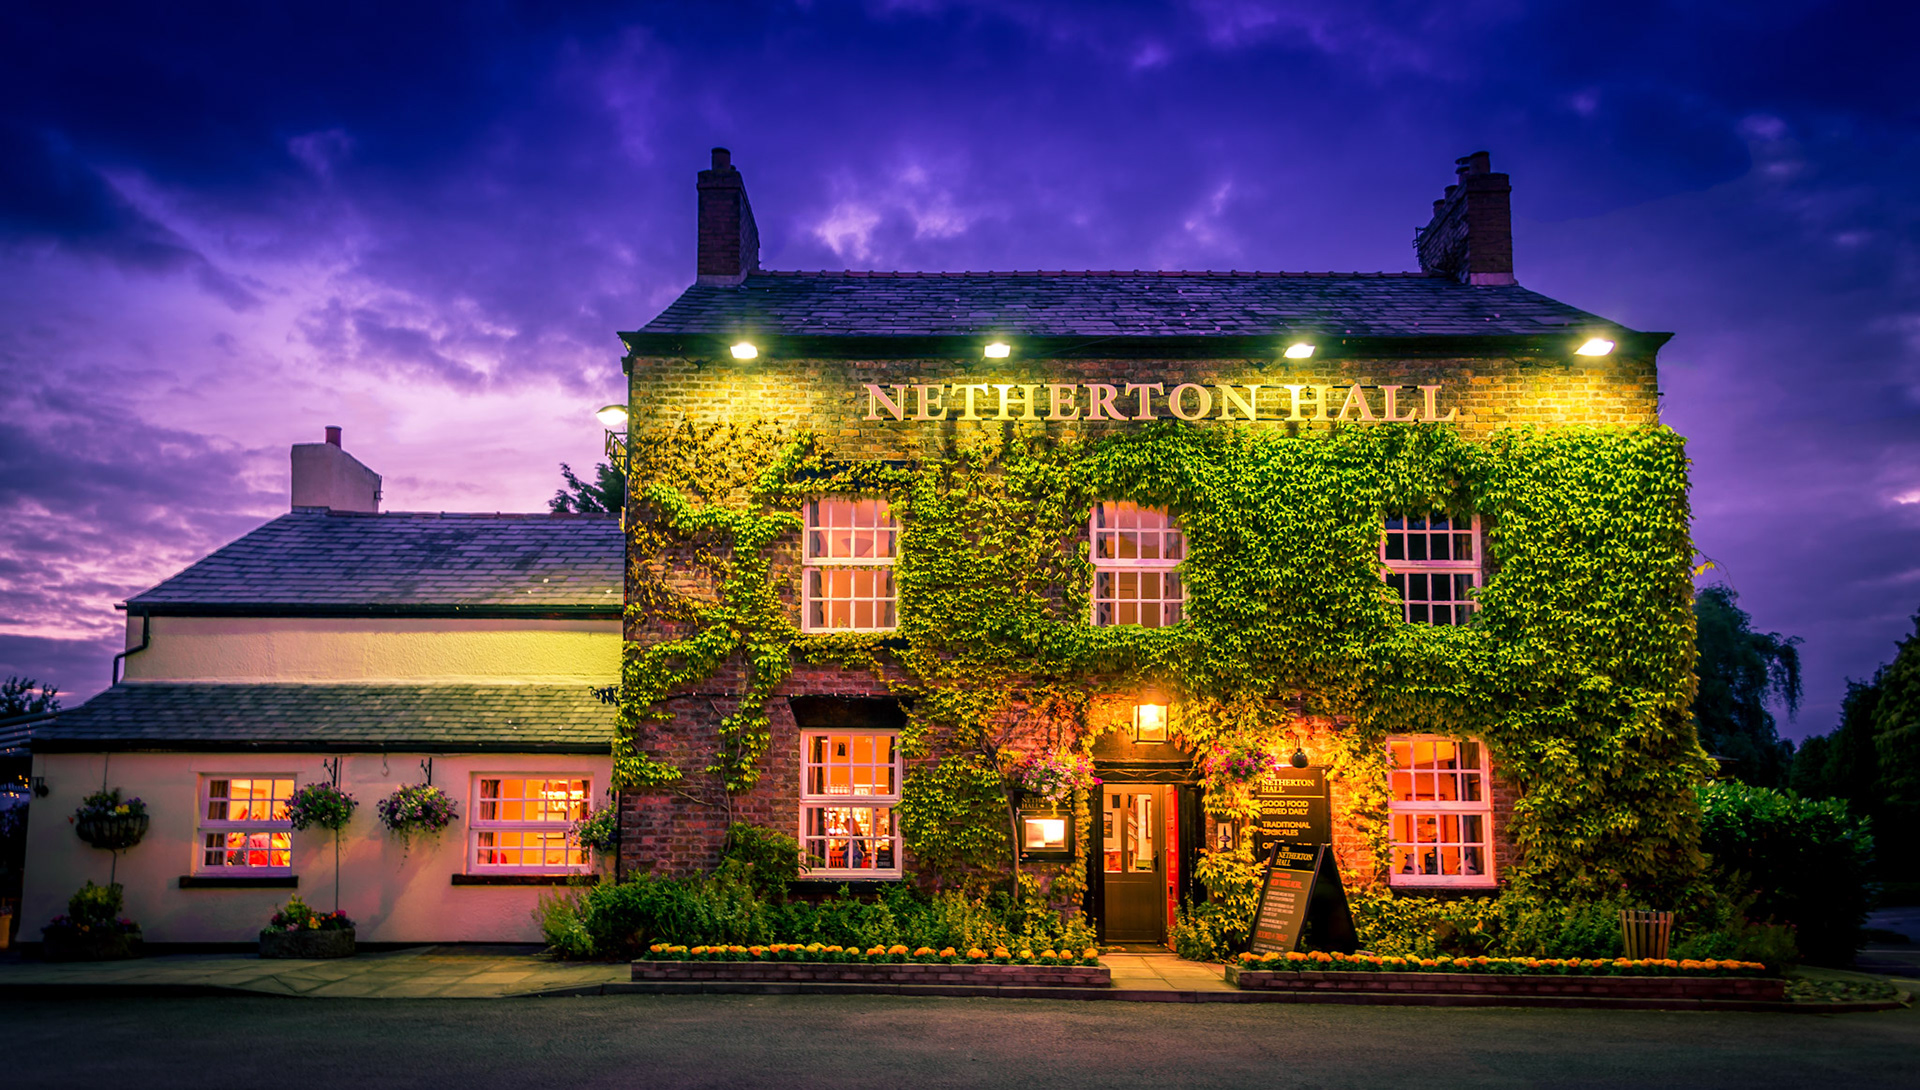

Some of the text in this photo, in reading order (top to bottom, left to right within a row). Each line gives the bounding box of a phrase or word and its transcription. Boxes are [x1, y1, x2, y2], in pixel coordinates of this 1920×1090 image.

[862, 382, 1457, 422] NETHERTON HALL
[1262, 779, 1315, 787] NETHERTON
[1286, 800, 1309, 808] FOOD
[1261, 807, 1287, 815] SERVED
[1262, 821, 1311, 829] TRADITIONAL
[1277, 851, 1314, 861] NETHERTON
[1275, 858, 1291, 867] HALL
